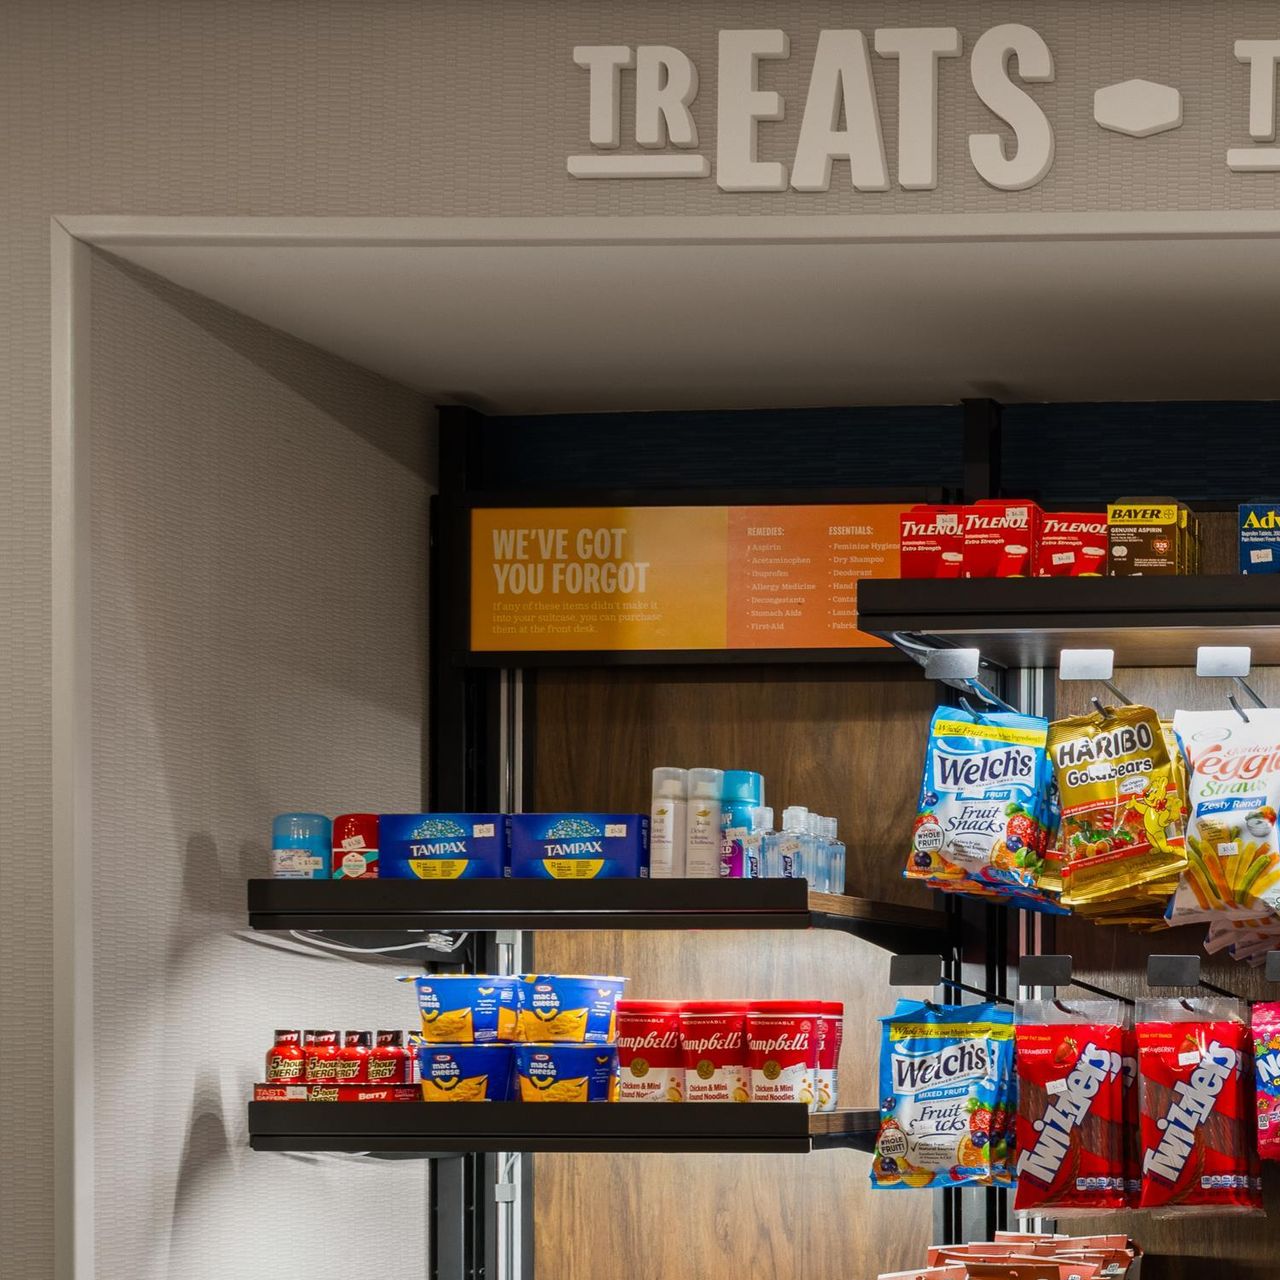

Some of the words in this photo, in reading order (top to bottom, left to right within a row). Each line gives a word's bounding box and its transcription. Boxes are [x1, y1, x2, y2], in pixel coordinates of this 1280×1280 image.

[570, 22, 1056, 192] TREATS
[1111, 509, 1162, 519] BAYER
[966, 515, 1028, 530] TYLENOL
[1043, 520, 1108, 533] TYLENOL
[829, 527, 873, 536] ESSENTIALS:
[492, 528, 568, 560] WE'VE
[576, 528, 627, 560] GOT
[752, 543, 782, 551] Aspirin
[752, 557, 811, 565] Acetaminophen
[833, 556, 847, 564] Dry
[849, 556, 884, 564] Shampoo
[493, 562, 544, 594] YOU
[552, 561, 650, 594] FORGOT
[752, 583, 780, 591] Allergy
[833, 582, 853, 590] Hand
[534, 602, 560, 610] these
[562, 602, 589, 610] items
[1059, 724, 1152, 768] HARIBO
[938, 748, 1032, 786] Welch's
[985, 791, 1008, 799] FRUIT
[960, 804, 1001, 820] Fruit
[1201, 800, 1230, 813] Zesty
[1232, 798, 1262, 809] Ranch
[945, 816, 1005, 833] Snacks
[918, 831, 941, 839] WHOLE
[409, 841, 467, 856] TAMPAX
[544, 841, 602, 856] TAMPAX
[895, 1045, 987, 1088] Welch's
[358, 1091, 387, 1100] Berry
[918, 1090, 941, 1099] MIXED
[943, 1086, 967, 1096] FRUIT
[919, 1104, 963, 1122] Fruit
[880, 1138, 903, 1146] WHOLE
